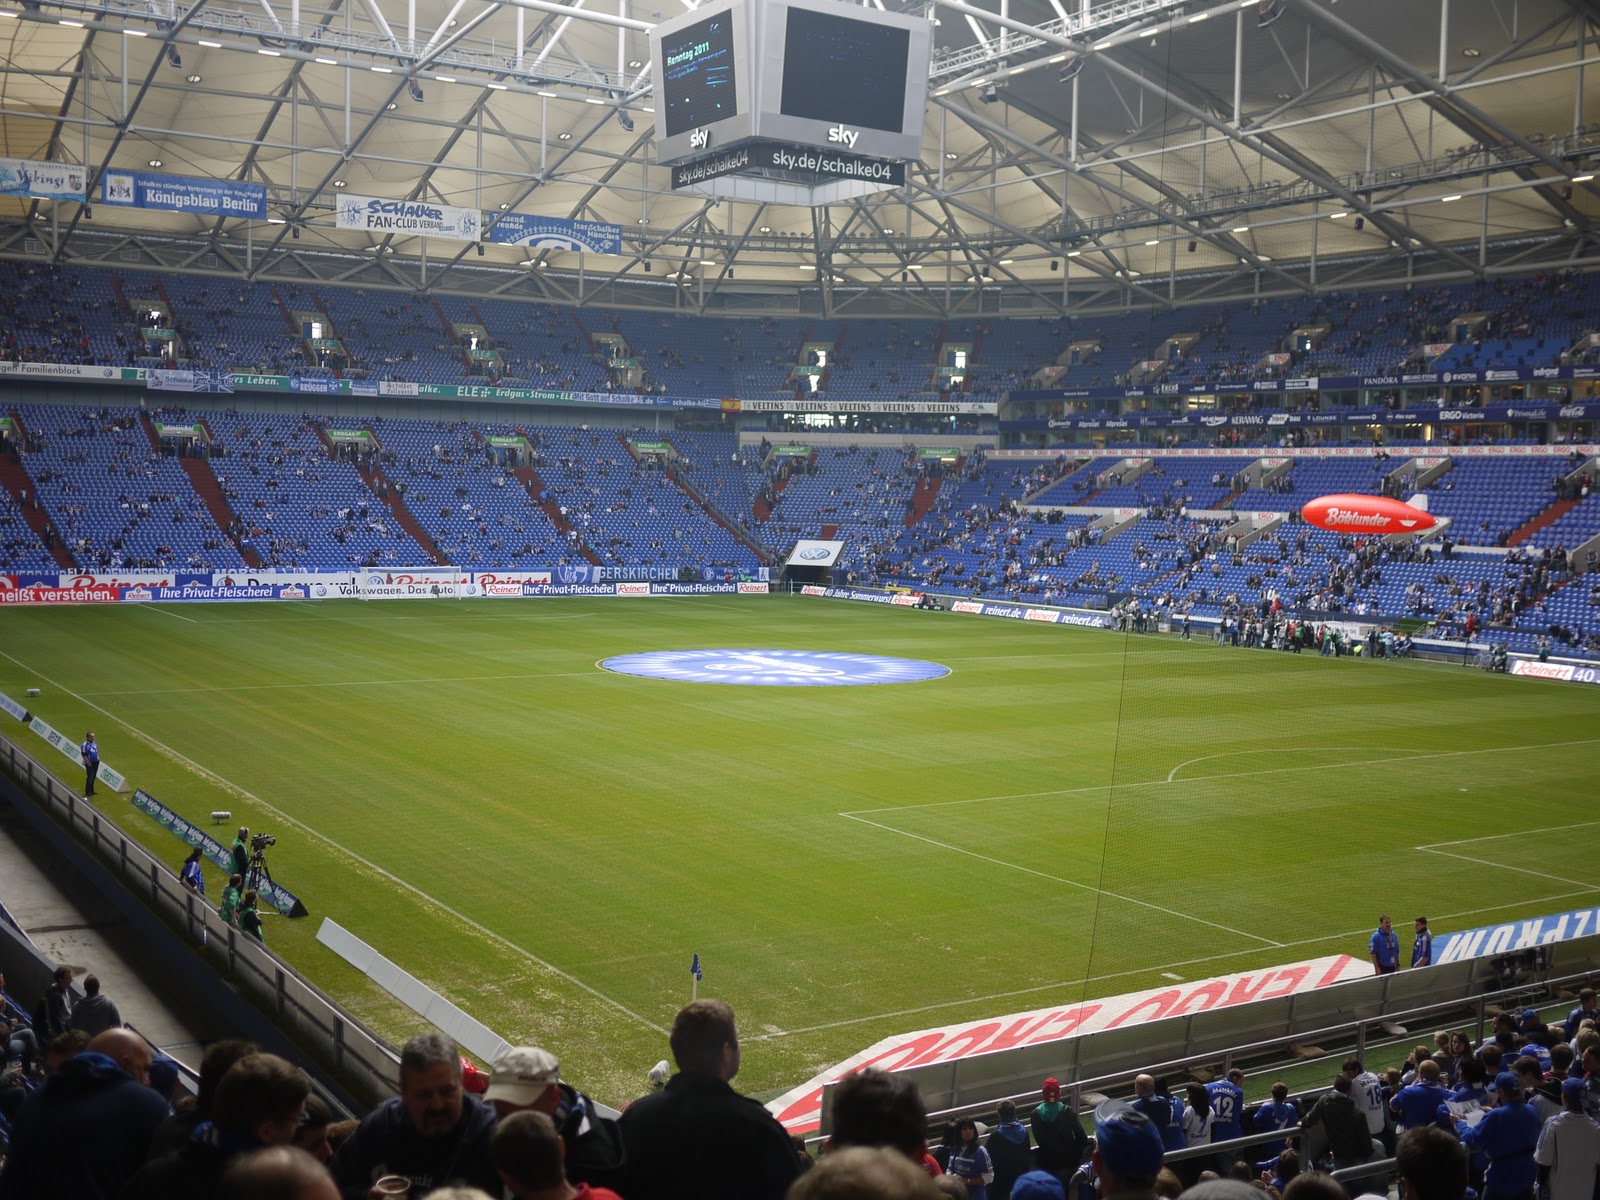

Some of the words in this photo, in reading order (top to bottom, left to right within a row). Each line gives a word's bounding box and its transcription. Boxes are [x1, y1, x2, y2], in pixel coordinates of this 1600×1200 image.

[667, 49, 693, 66] Renntag
[694, 41, 709, 56] 2011
[690, 127, 709, 148] sky
[828, 124, 859, 148] sky
[678, 150, 749, 184] sky.de/schalke04
[773, 150, 892, 180] sky.de/schalke04
[146, 189, 218, 208] Königsblau
[222, 196, 258, 212] Berlin
[367, 215, 418, 229] FAN-CLUB
[420, 220, 443, 229] VERBAND
[587, 230, 620, 240] München
[21, 364, 82, 375] Familienblock
[247, 376, 280, 386] Leben.
[300, 383, 328, 393] BRÜGGEN
[456, 386, 479, 397] ELE
[496, 389, 525, 399] Erdgas
[530, 391, 555, 399] Strom
[752, 401, 785, 411] VELTINS
[795, 402, 828, 411] VELTINS
[838, 402, 872, 411] VELTINS
[882, 403, 916, 412] VELTINS
[926, 403, 961, 413] VELTINS
[1231, 415, 1264, 425] KERAMAG
[1439, 411, 1461, 421] ERGO
[1462, 411, 1485, 420] Victoria
[1257, 513, 1274, 521] ERGO
[1325, 507, 1391, 527] Böklunder
[600, 567, 679, 580] GERSKIRCHEN
[160, 586, 181, 598] Ihre
[183, 586, 273, 599] Privat-Fleischerei
[339, 585, 405, 596] Volkswagen.
[408, 585, 427, 594] Das
[430, 585, 456, 594] uto.
[487, 585, 521, 595] Reinert
[523, 584, 540, 594] Ihre
[542, 584, 614, 594] Privat-Fleischerei
[617, 584, 648, 594] Reinert
[652, 584, 667, 593] Ihre
[669, 583, 736, 593] Privat-Fleischerei
[739, 584, 767, 593] Reinert
[39, 588, 115, 601] verstehen.
[824, 588, 833, 596] 40
[832, 588, 850, 599] Jahre
[849, 591, 893, 604] Sommerwurst
[954, 602, 981, 613] Reinert
[984, 605, 1022, 618] reinert.de
[1026, 609, 1058, 622] Reinert
[1061, 614, 1103, 627] reinert.de
[1515, 660, 1571, 678] Reinert
[1573, 669, 1595, 682] 40
[1366, 1085, 1382, 1106] 18
[1213, 1095, 1234, 1117] 12
